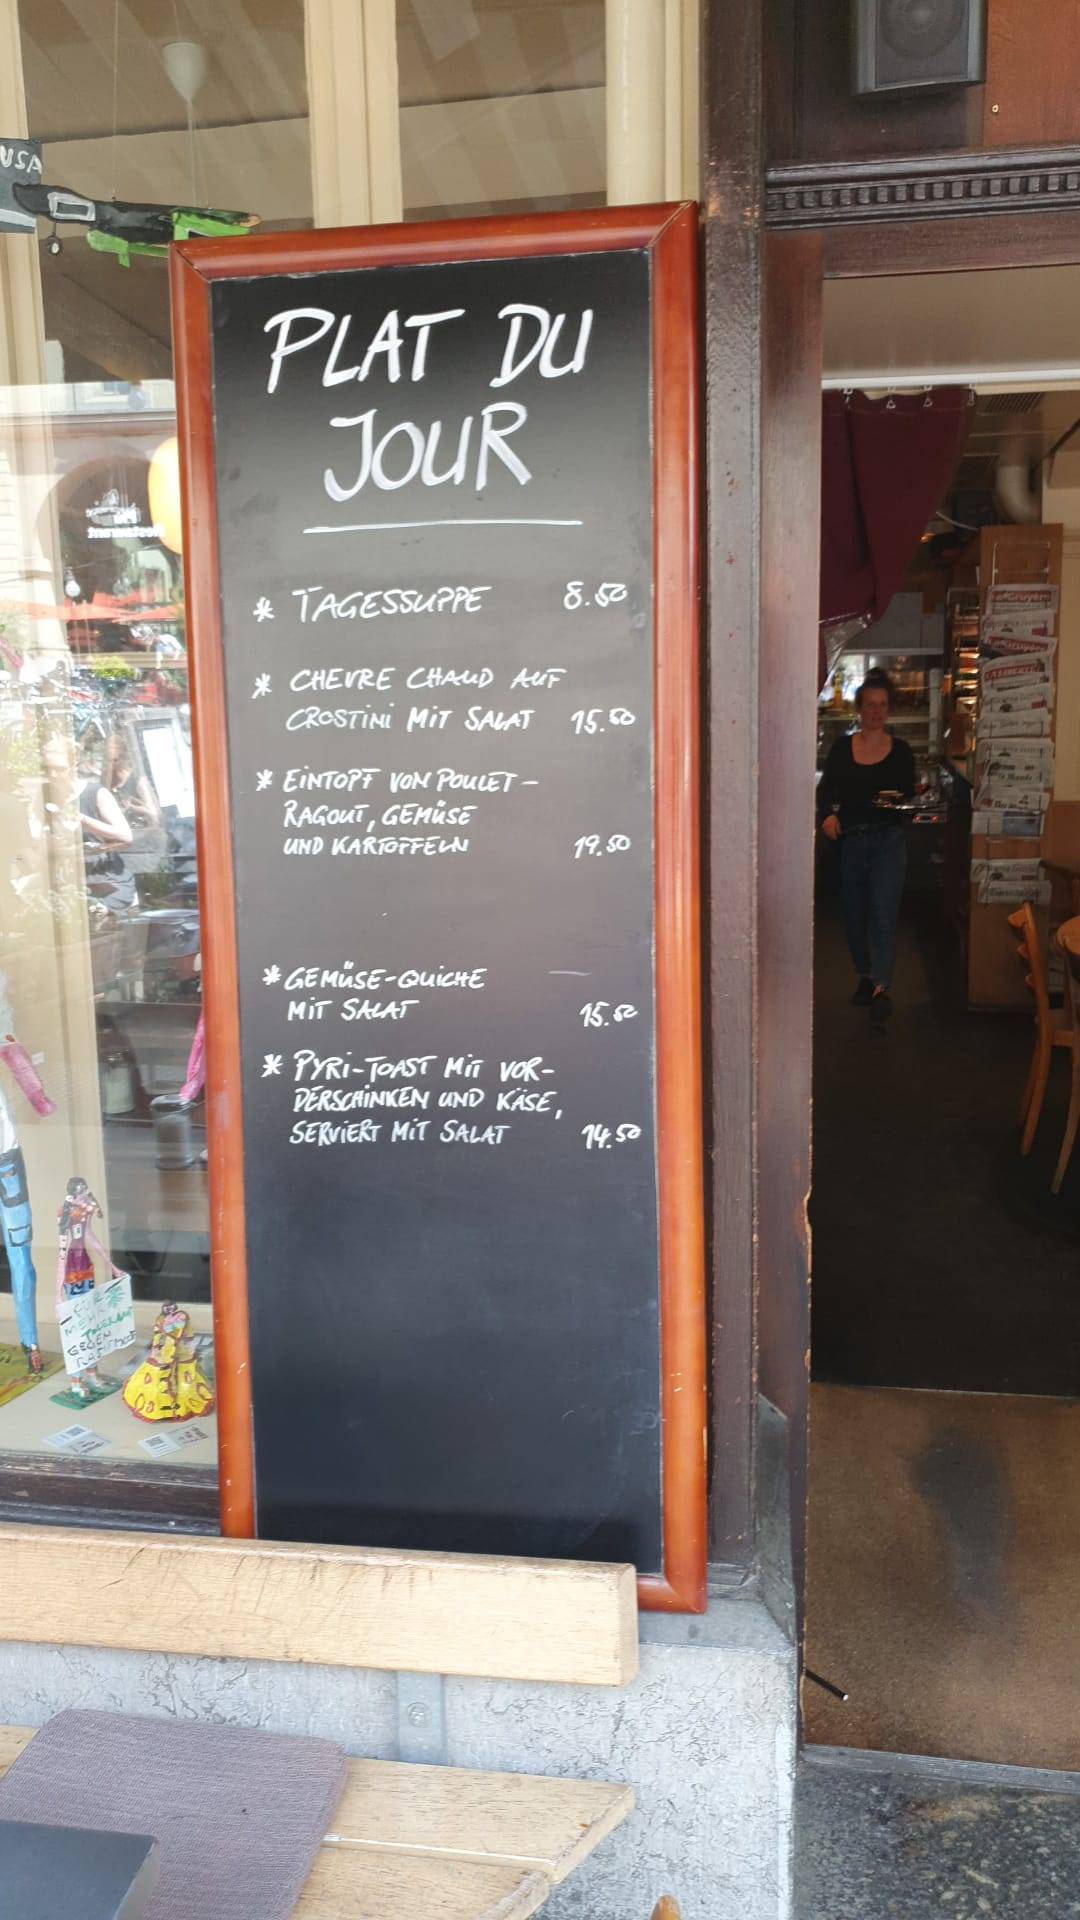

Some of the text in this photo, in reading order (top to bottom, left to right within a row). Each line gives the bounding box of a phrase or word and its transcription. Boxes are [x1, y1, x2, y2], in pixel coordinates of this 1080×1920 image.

[0, 144, 42, 175] USA
[263, 303, 594, 394] PLAT DU
[323, 402, 532, 502] JOUR
[291, 580, 628, 623] TAGESSUPPE 8.50
[289, 666, 567, 692] CHEVRE CHAUD AUF
[464, 706, 536, 732] SALAT
[570, 707, 636, 735] 15.50
[389, 771, 433, 793] VON
[283, 799, 479, 833] RAGOUT, GEMÜSE
[283, 834, 632, 859] UND KARTOFFELN 19.50
[340, 997, 420, 1022] SALAT
[579, 1000, 639, 1028] 15.50
[499, 1056, 556, 1083] VOR-
[437, 1088, 486, 1109] UND
[495, 1087, 563, 1121] KÄSE,
[439, 1119, 512, 1146] SALAT
[580, 1123, 642, 1150] 14.50
